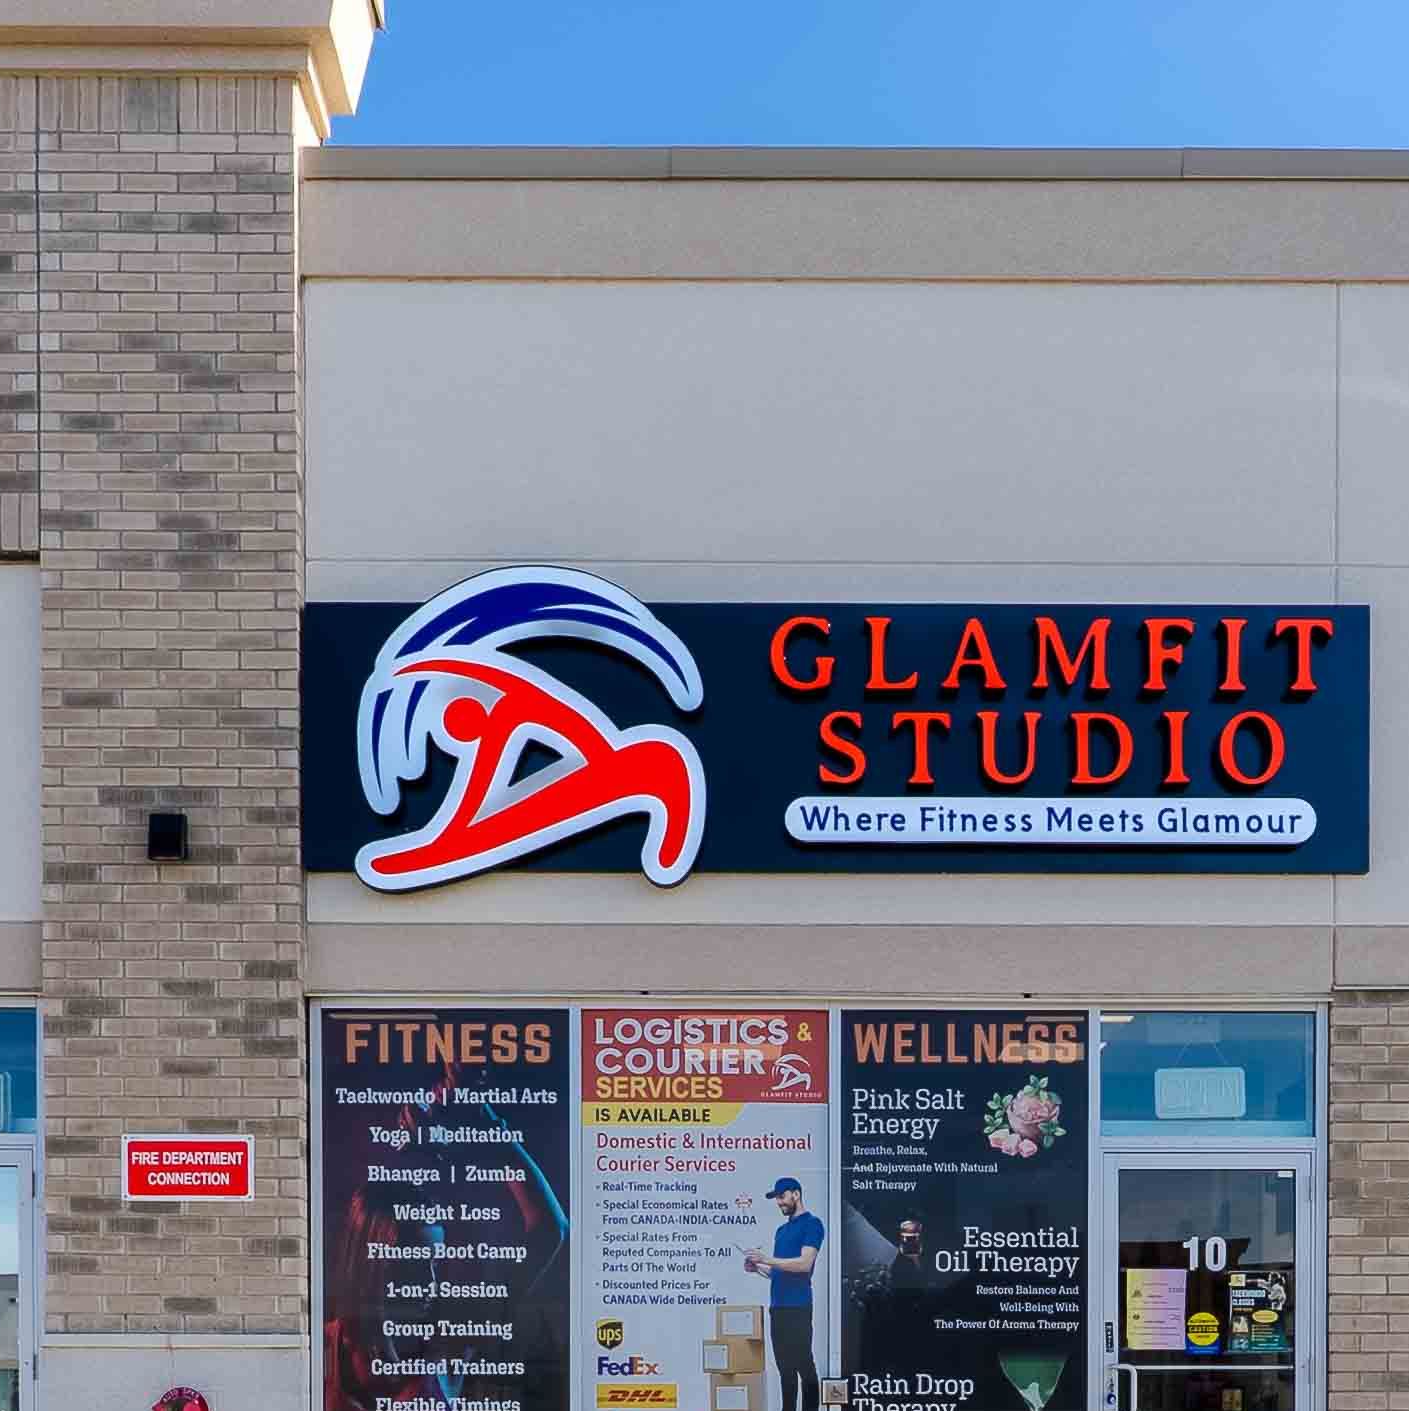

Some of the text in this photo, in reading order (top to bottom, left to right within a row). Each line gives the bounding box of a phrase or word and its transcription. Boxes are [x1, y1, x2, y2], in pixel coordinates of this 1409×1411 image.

[770, 616, 1332, 692] GLAMFIT
[818, 711, 1287, 786] STUDIO
[799, 804, 1303, 835] Where Fitness Meets Glamour
[595, 1018, 812, 1045] LOGISTICS &
[346, 1023, 552, 1064] FITNESS
[854, 1023, 1078, 1064] WELLNESS
[595, 1048, 768, 1075] COURIER
[335, 1087, 558, 1104] Taekwondo Martial Arts
[596, 1076, 723, 1099] SERVICES
[852, 1088, 965, 1110] Pink Salt
[595, 1108, 712, 1122] IS AVAILABLE
[852, 1113, 940, 1140] Energy
[369, 1125, 524, 1148] Yoga Meditation
[597, 1132, 812, 1150] Domestic & International
[132, 1151, 244, 1166] FIRE DEPARTMENT
[597, 1156, 736, 1173] Courier Services
[368, 1166, 526, 1185] Bhangra Zumba
[852, 1163, 998, 1175] And Rejuvenate With Natural
[148, 1172, 230, 1187] CONNECTION
[603, 1182, 697, 1194] Real-Time Tracking
[852, 1180, 917, 1192] Salt Therapy
[393, 1204, 501, 1224] Weight Loss
[603, 1200, 729, 1212] Special Economical Rates
[603, 1215, 628, 1225] From
[603, 1232, 698, 1244] Special Rates From
[963, 1226, 1079, 1248] Essential
[367, 1242, 527, 1262] Fitness Boot Camp
[603, 1247, 732, 1259] Reputed Companies To All
[1182, 1236, 1227, 1272] 10
[603, 1263, 697, 1273] Parts Of The World
[935, 1250, 1080, 1277] Oil Therapy
[386, 1282, 508, 1298] 1-on-1 Session
[603, 1280, 712, 1290] Discounted Prices For
[976, 1285, 1080, 1295] Restore Balance And
[603, 1295, 727, 1305] CANADA Wide Deliveries
[999, 1302, 1080, 1314] Well-Being With
[382, 1320, 513, 1341] Group Training
[934, 1319, 1080, 1332] The Power Of Aroma Therapy
[597, 1327, 622, 1345] ups
[371, 1358, 525, 1375] Certified Trainers
[597, 1356, 658, 1376] FedEx
[852, 1373, 974, 1400] Rain Drop
[608, 1390, 666, 1402] DHL
